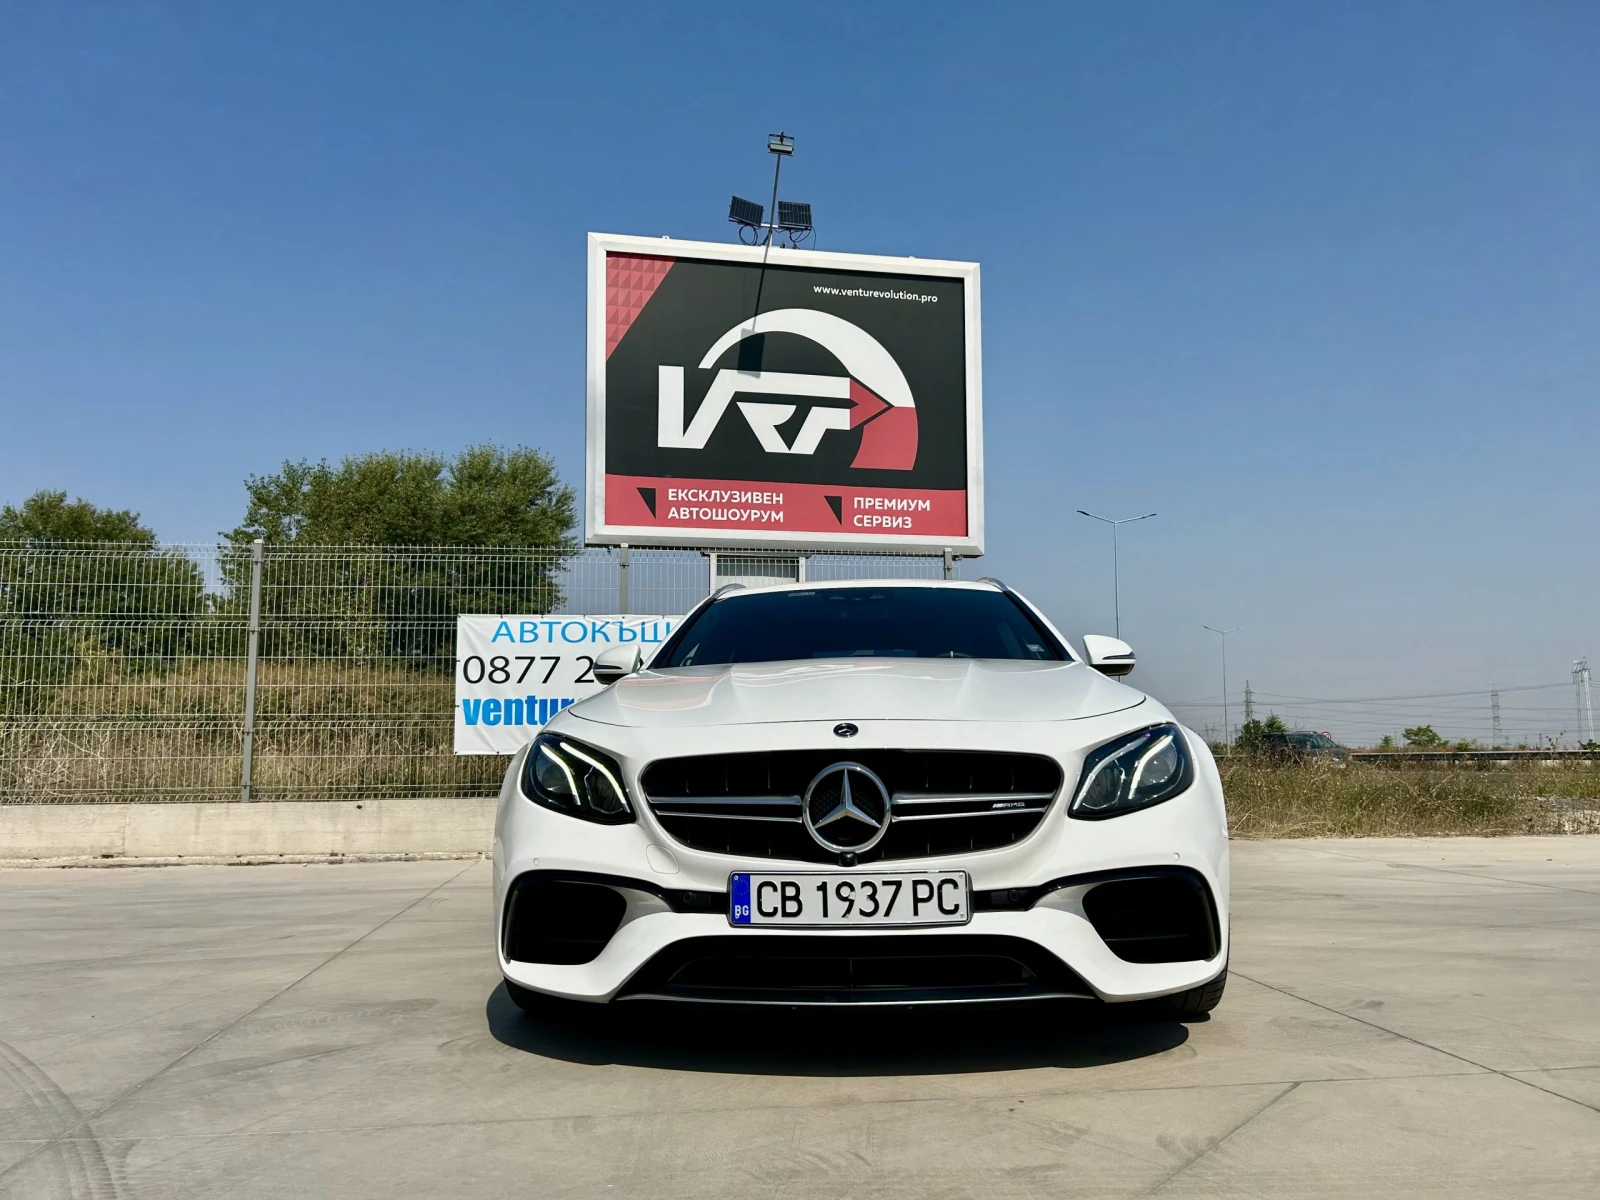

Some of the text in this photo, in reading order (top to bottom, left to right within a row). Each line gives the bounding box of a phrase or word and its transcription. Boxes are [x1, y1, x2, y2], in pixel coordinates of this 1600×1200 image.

[813, 285, 938, 303] www.venturevolution.pro
[667, 488, 784, 505] ЕКСКЛУЗИВЕН
[853, 497, 931, 512] ПРЕМИУМ
[667, 507, 784, 523] АВТОШОУРУМ
[853, 515, 913, 529] СЕРВИЗ
[462, 655, 561, 684] 0877
[756, 878, 960, 918] CB 1937 PC
[734, 904, 749, 919] BG
